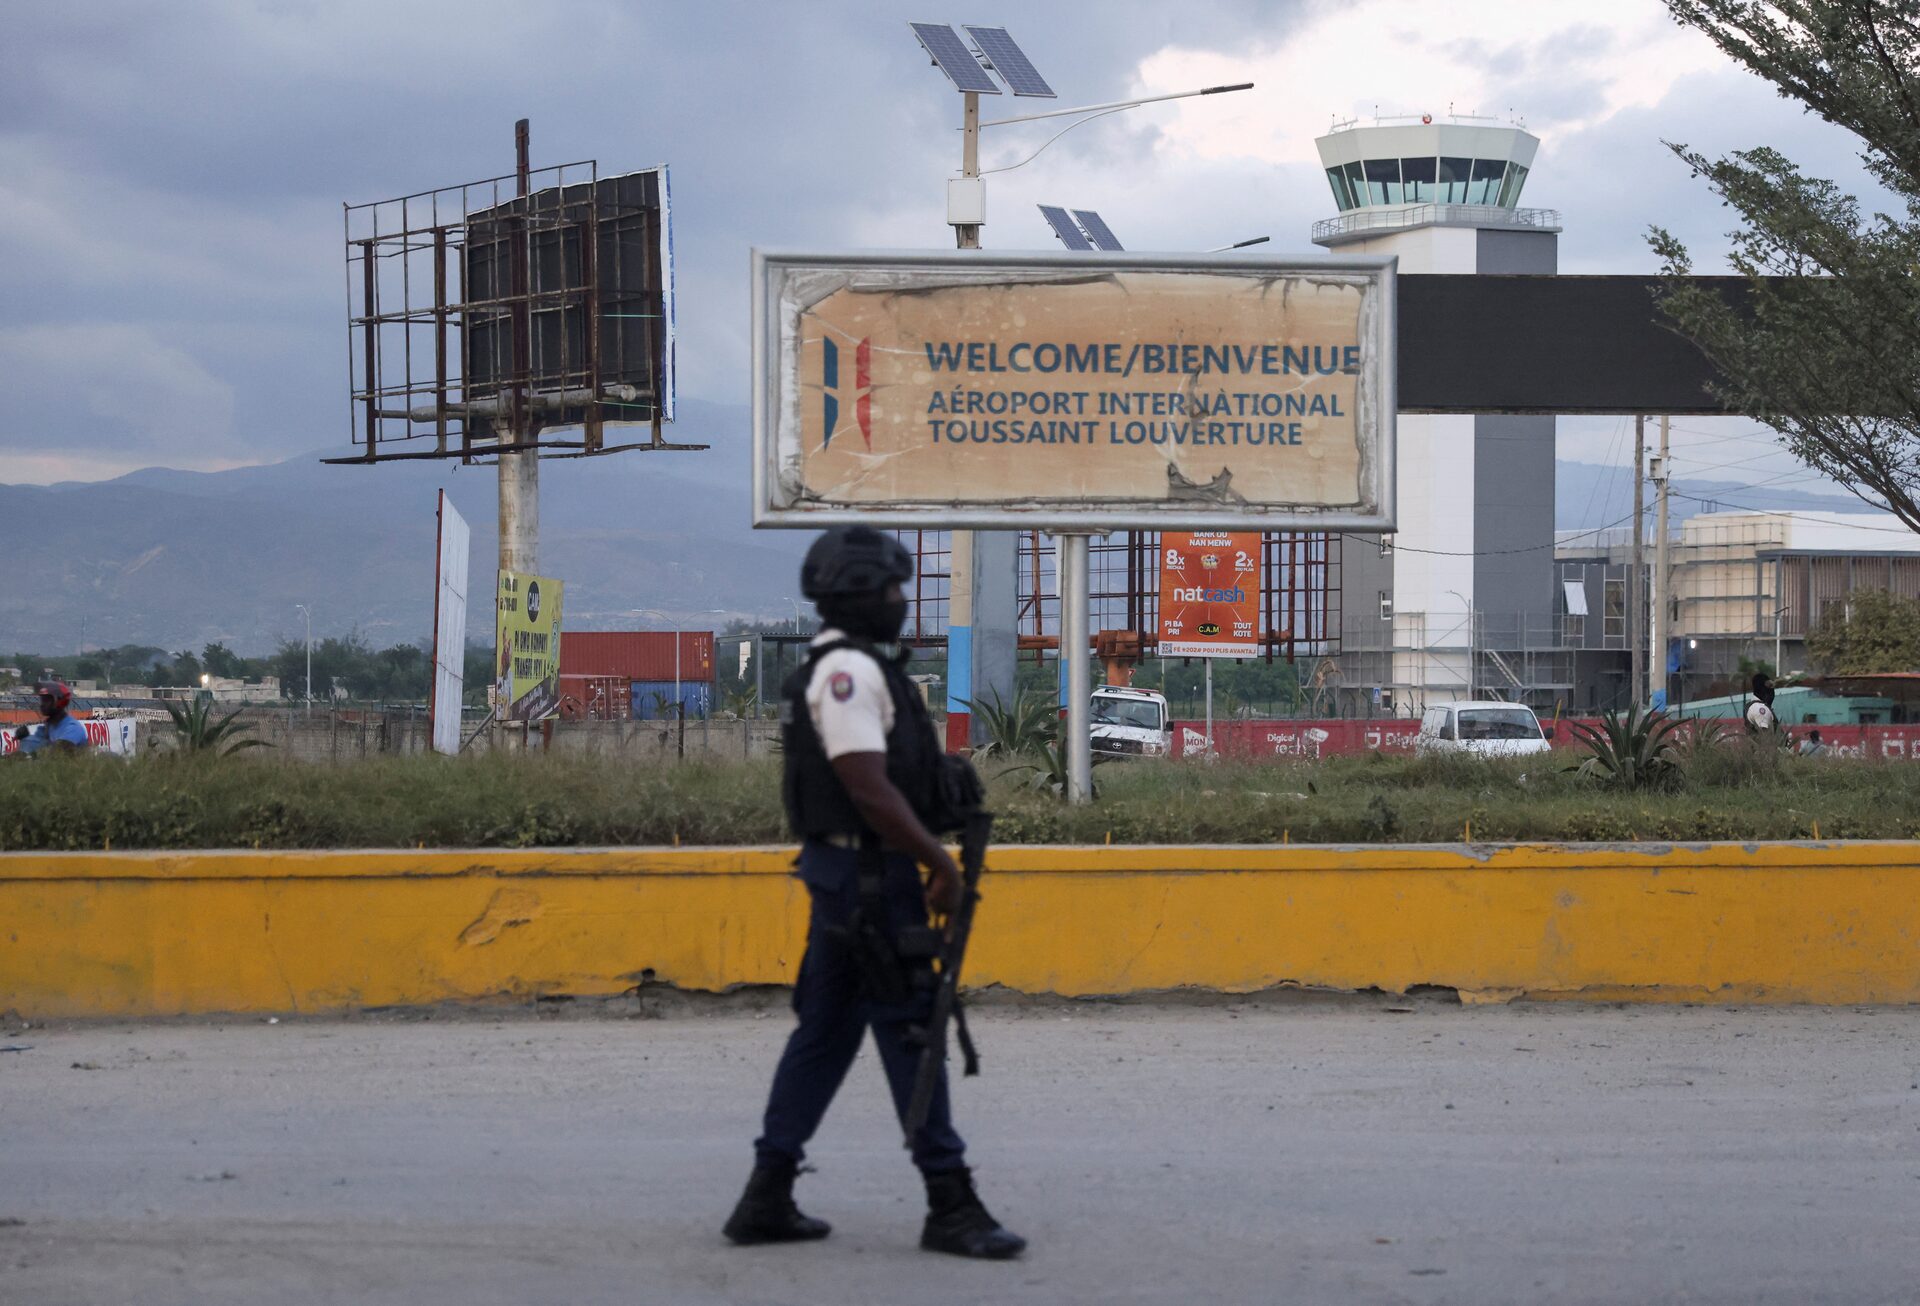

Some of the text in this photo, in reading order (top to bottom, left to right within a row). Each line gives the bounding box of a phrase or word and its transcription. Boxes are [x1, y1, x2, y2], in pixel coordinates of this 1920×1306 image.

[925, 342, 1360, 377] WELCOME/BIENVENUE
[927, 384, 1089, 414] AÉROPORT
[927, 420, 1302, 446] TOUSSAINT LOUVERTURE
[1173, 585, 1245, 603] natcash
[1186, 738, 1206, 747] MON
[1267, 733, 1295, 744] Digicel
